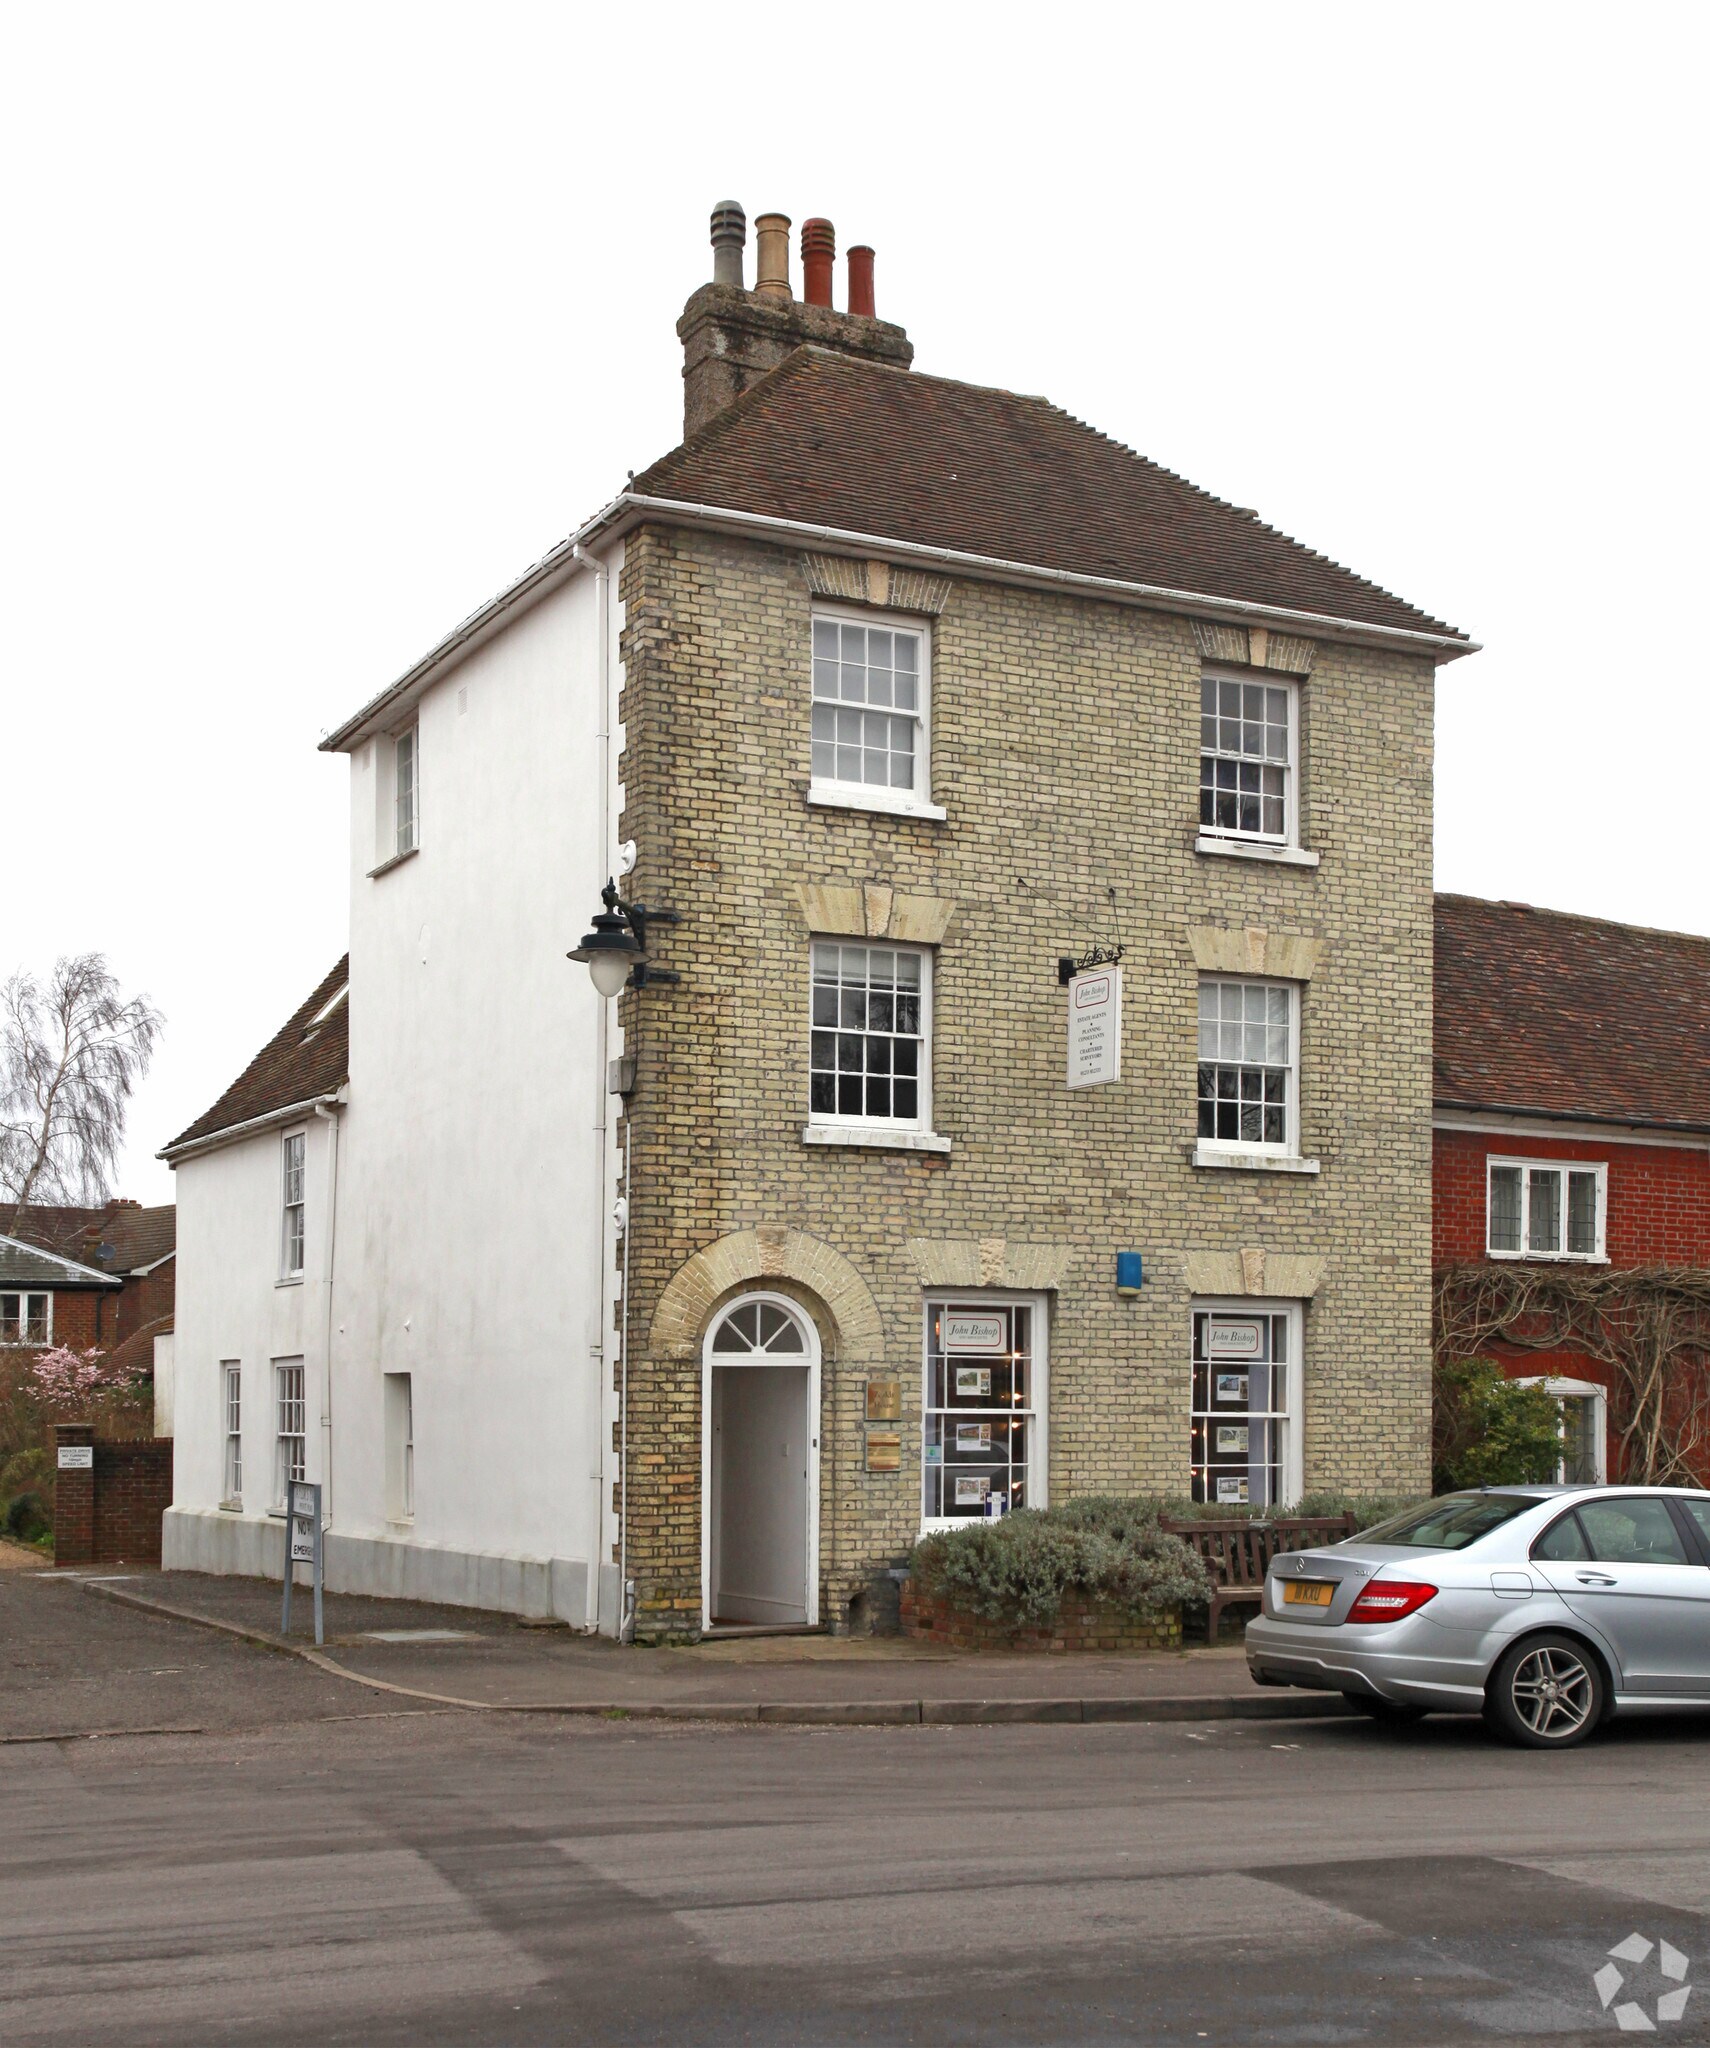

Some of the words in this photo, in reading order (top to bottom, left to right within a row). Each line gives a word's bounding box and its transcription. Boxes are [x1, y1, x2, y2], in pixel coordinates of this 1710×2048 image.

[1079, 989, 1090, 999] John
[1091, 986, 1105, 995] Bishop
[1077, 1015, 1090, 1023] ESTATE
[1082, 1026, 1101, 1035] PLANNING
[1078, 1032, 1104, 1042] CONSULTANTS
[1079, 1045, 1102, 1055] CHARTERED
[1079, 1053, 1102, 1061] SURVEYORS
[949, 1324, 968, 1335] John
[970, 1324, 998, 1338] Bishop
[1211, 1331, 1229, 1341] John
[1230, 1331, 1255, 1343] Bishop
[298, 1520, 307, 1536] NO
[294, 1545, 314, 1557] EMERG
